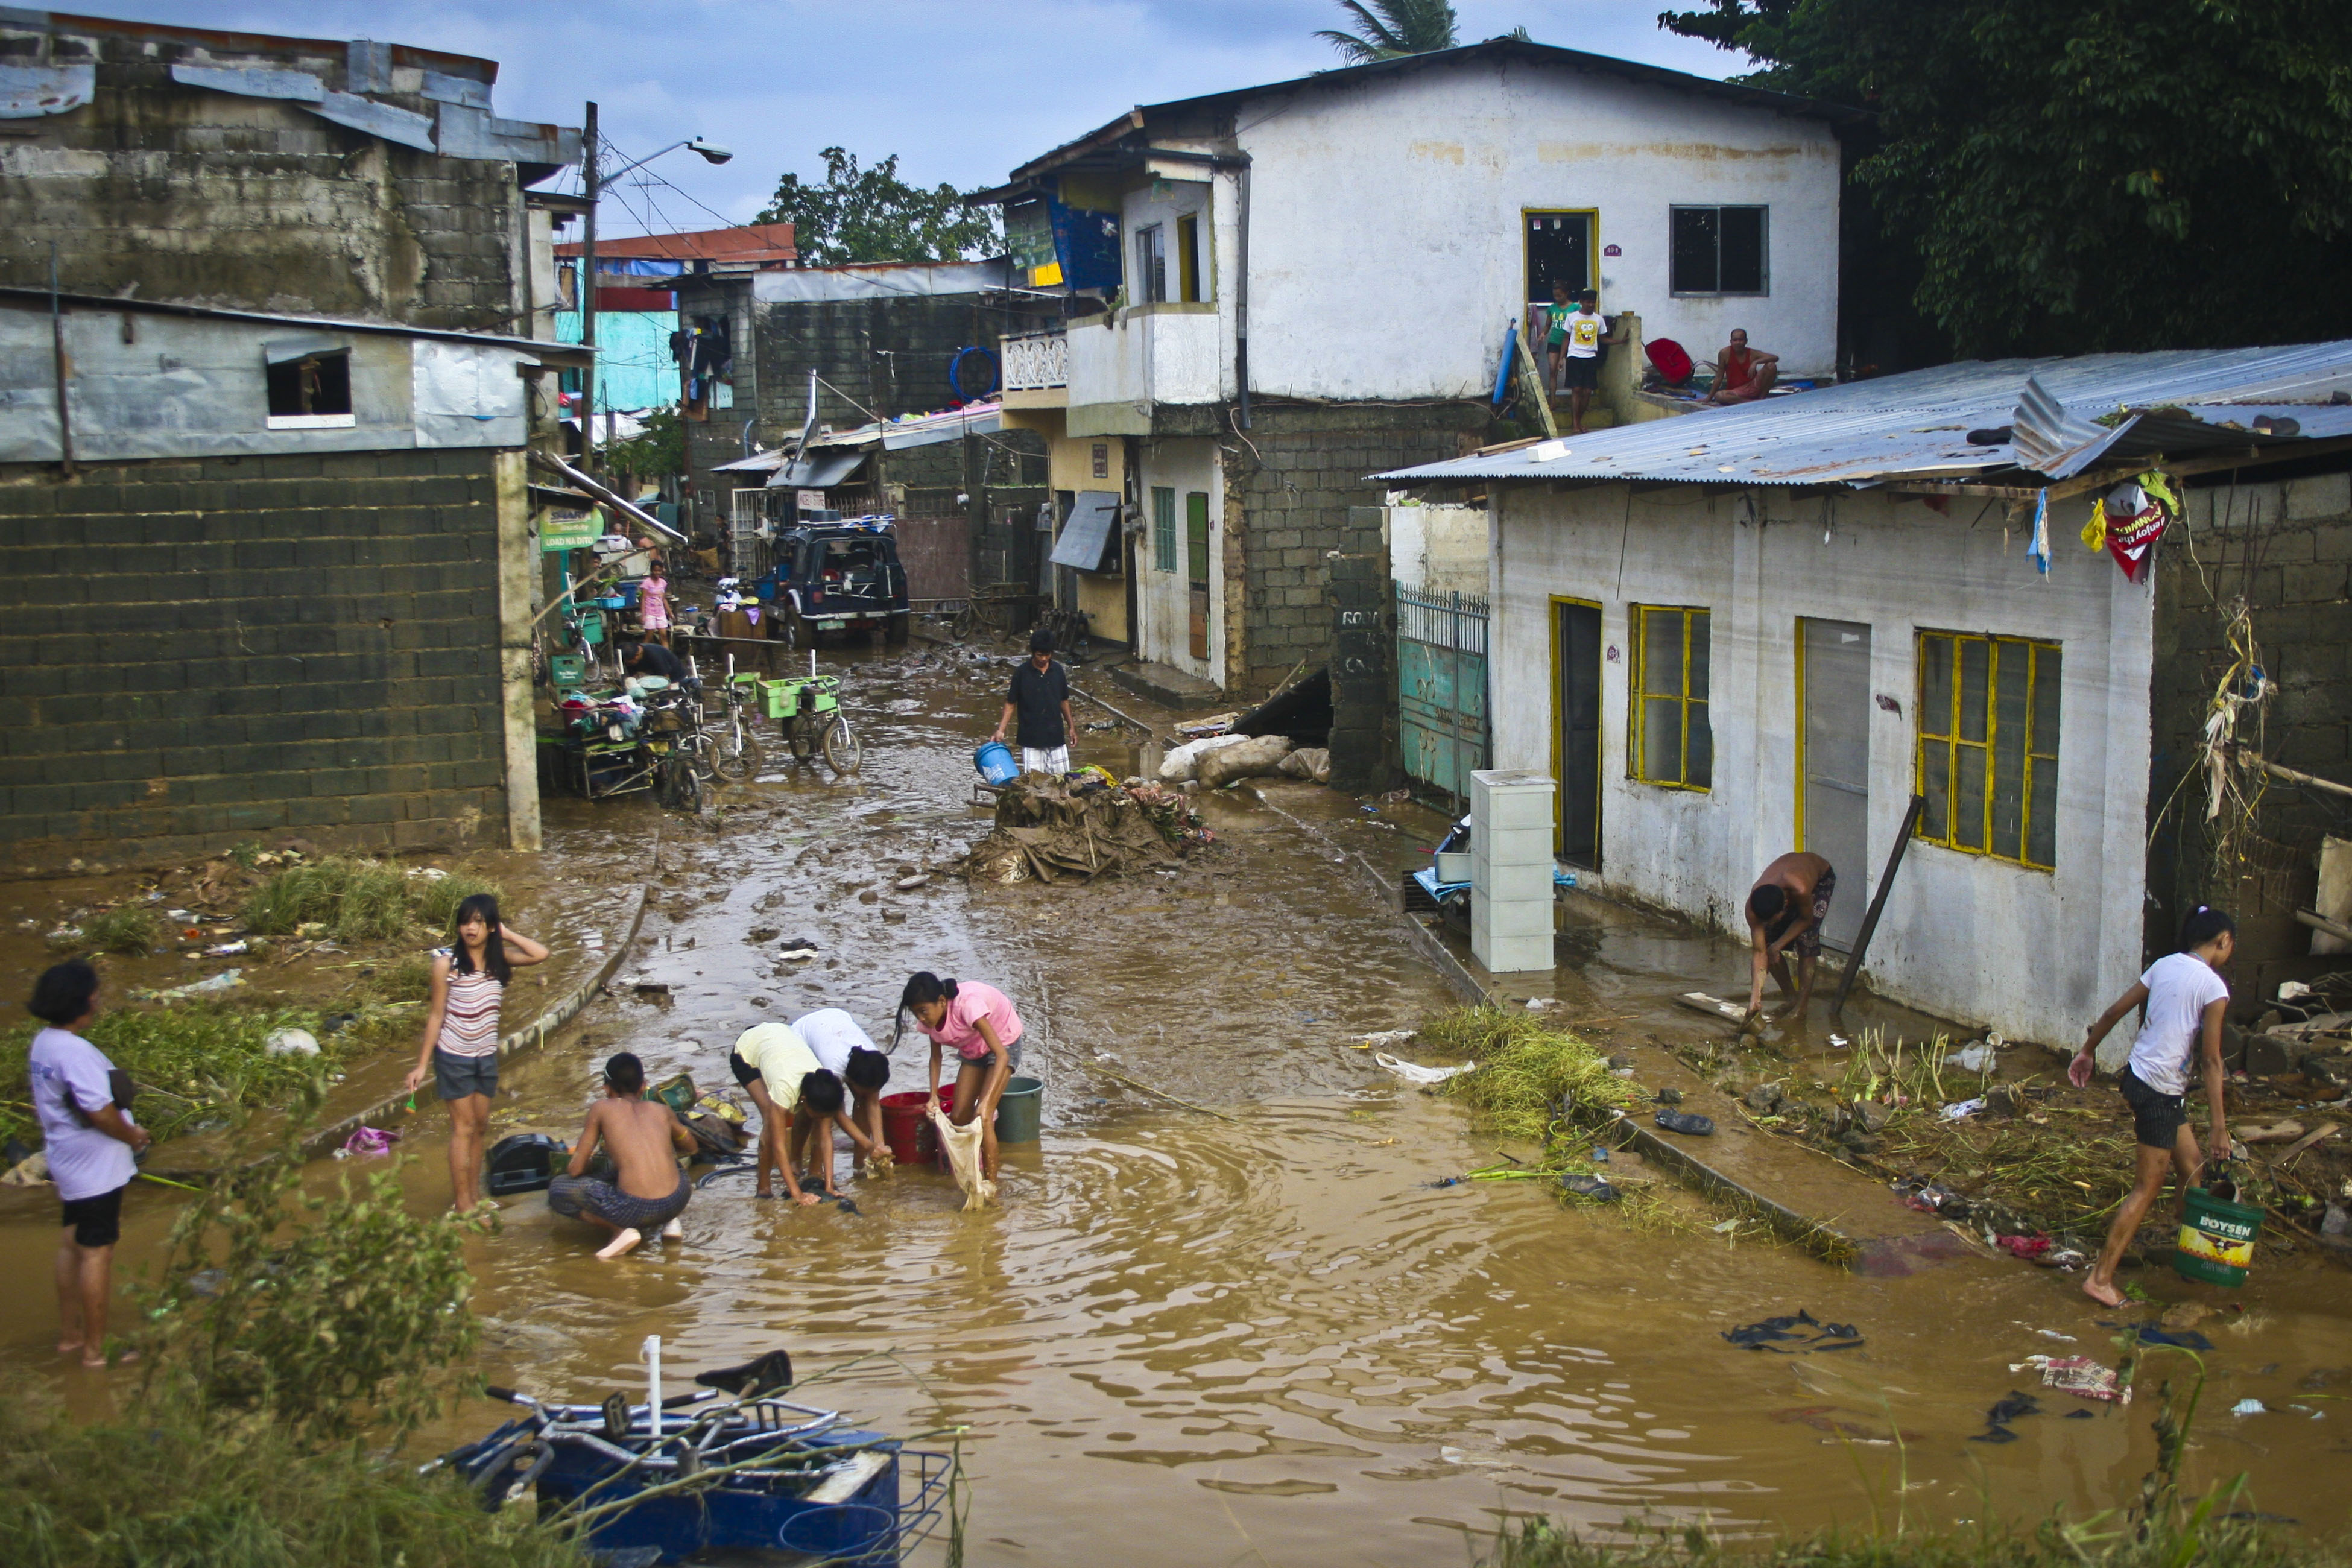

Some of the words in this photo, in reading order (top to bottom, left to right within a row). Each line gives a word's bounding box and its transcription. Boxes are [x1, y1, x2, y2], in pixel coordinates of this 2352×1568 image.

[2136, 520, 2161, 540] enjoy
[546, 537, 565, 546] LOAD
[577, 536, 593, 545] DITO
[2118, 534, 2135, 545] the
[2199, 1215, 2251, 1236] BOYSEN
